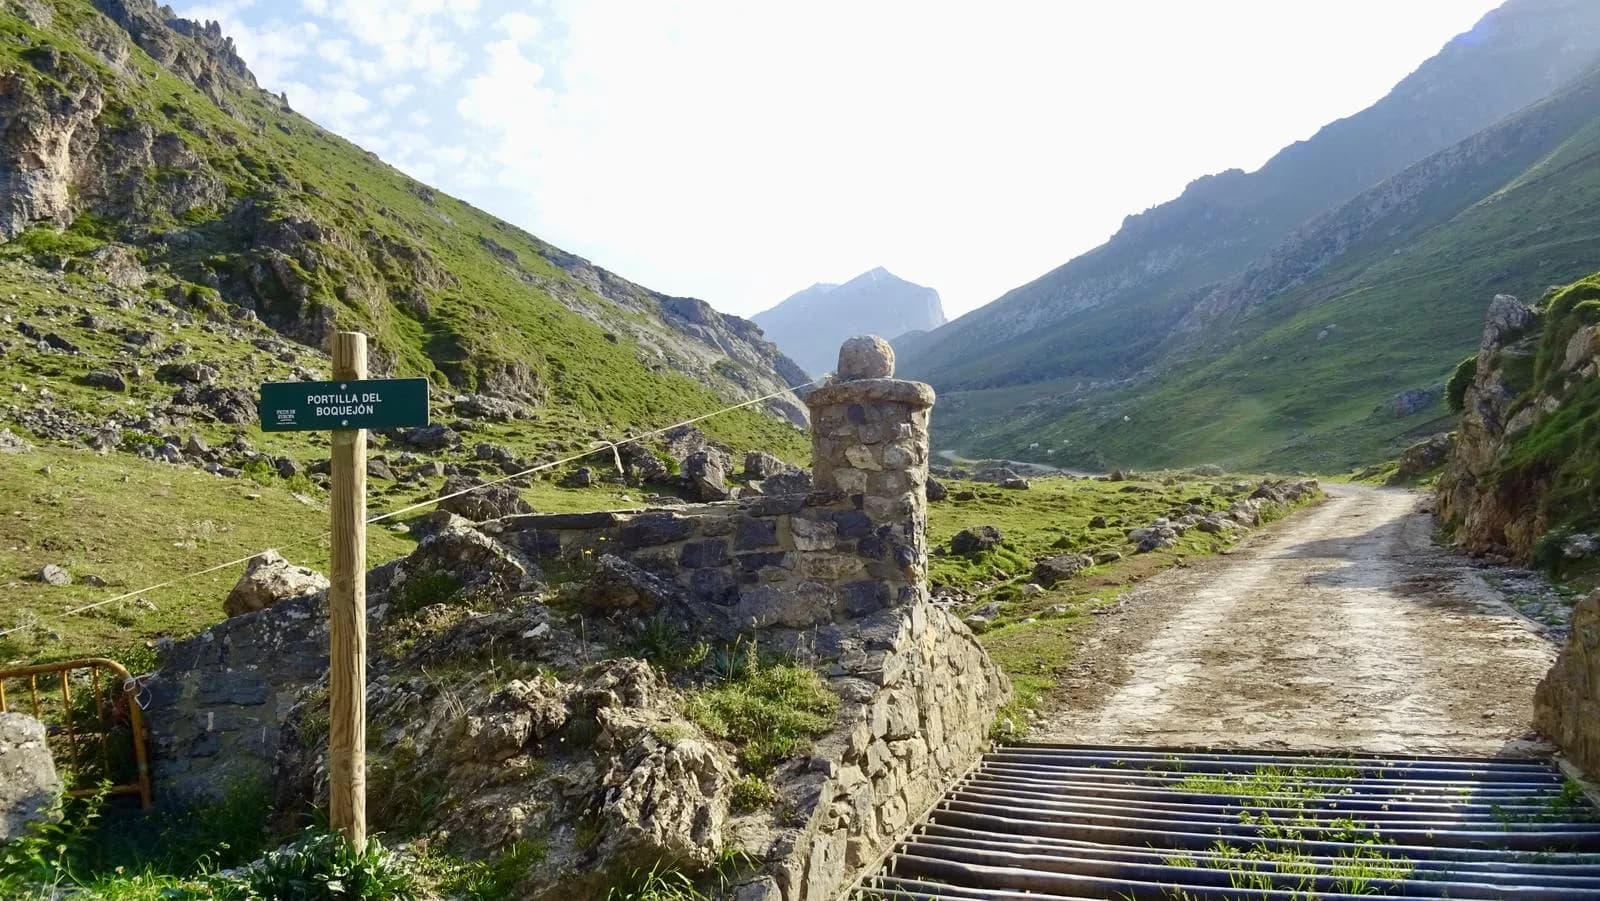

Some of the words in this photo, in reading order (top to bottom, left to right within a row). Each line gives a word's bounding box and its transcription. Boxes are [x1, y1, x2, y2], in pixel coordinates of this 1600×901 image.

[307, 394, 358, 405] PORTILLA
[362, 392, 382, 403] DEL
[316, 404, 374, 416] BOQUEJÓN
